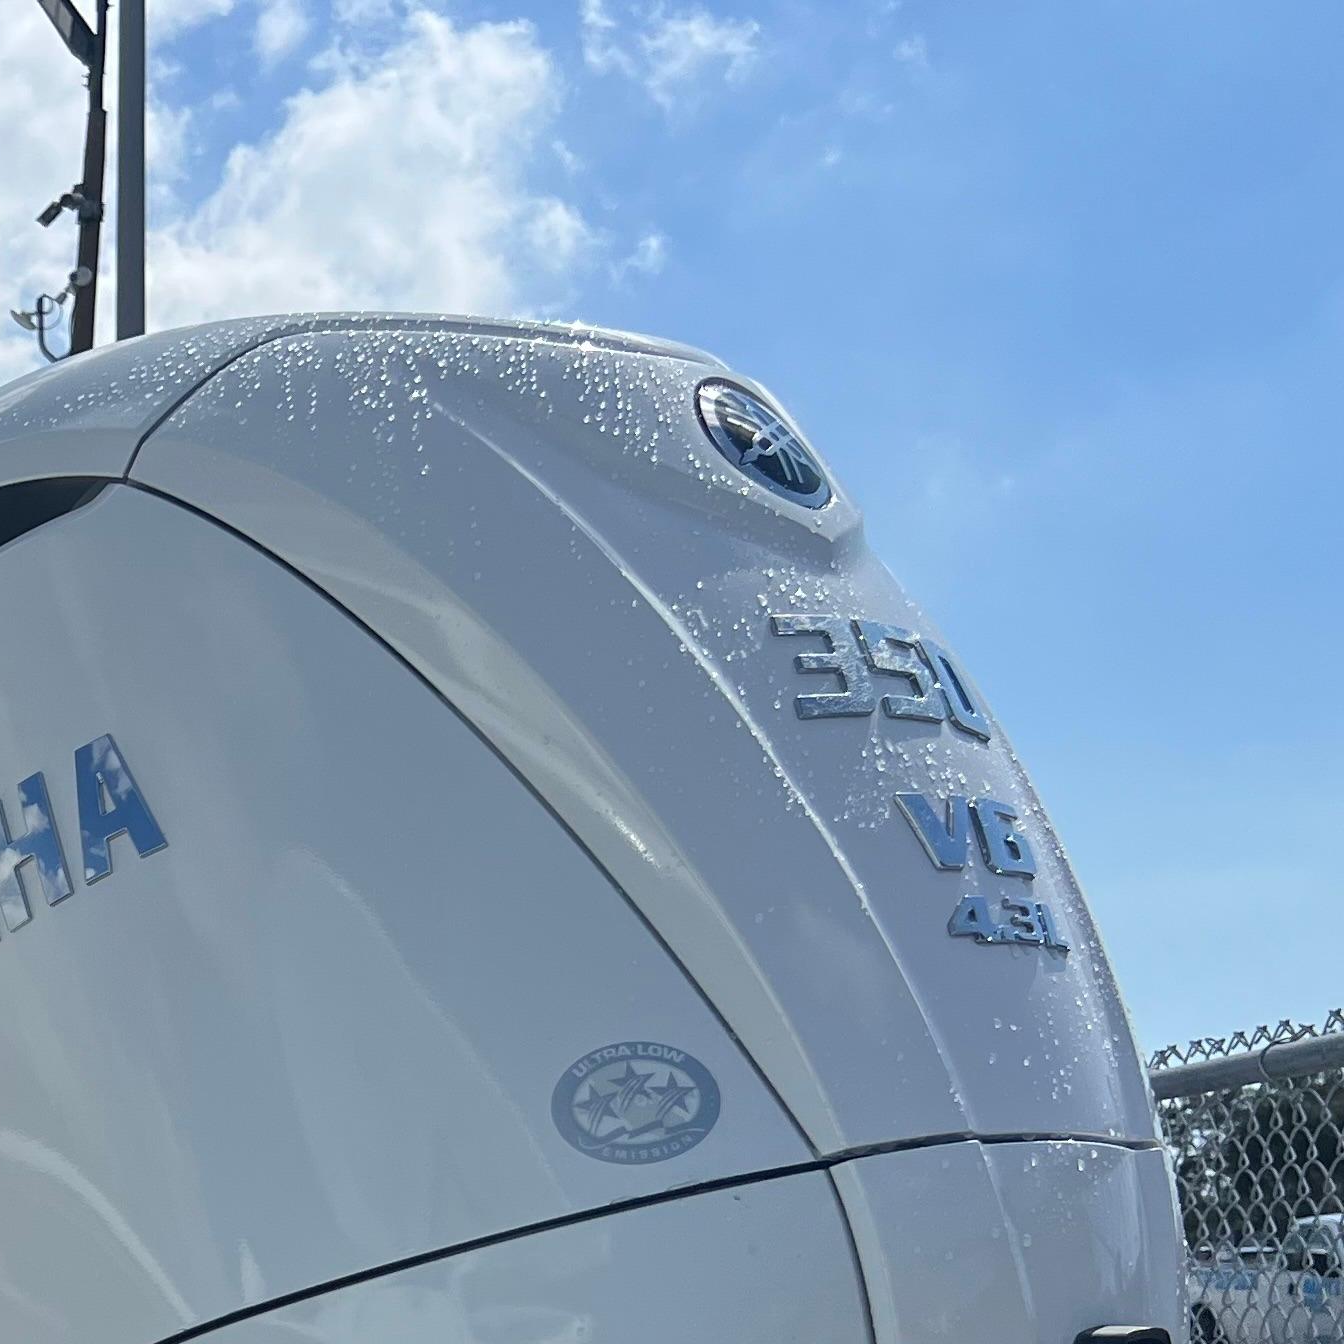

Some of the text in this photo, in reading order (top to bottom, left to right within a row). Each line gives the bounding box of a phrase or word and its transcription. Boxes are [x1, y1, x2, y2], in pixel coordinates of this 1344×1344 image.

[770, 613, 991, 744] 350
[894, 792, 1037, 881] V6
[947, 895, 1071, 952] 4.3L
[572, 1043, 686, 1078] ULTRA LOW
[603, 1134, 694, 1160] EMISSION
